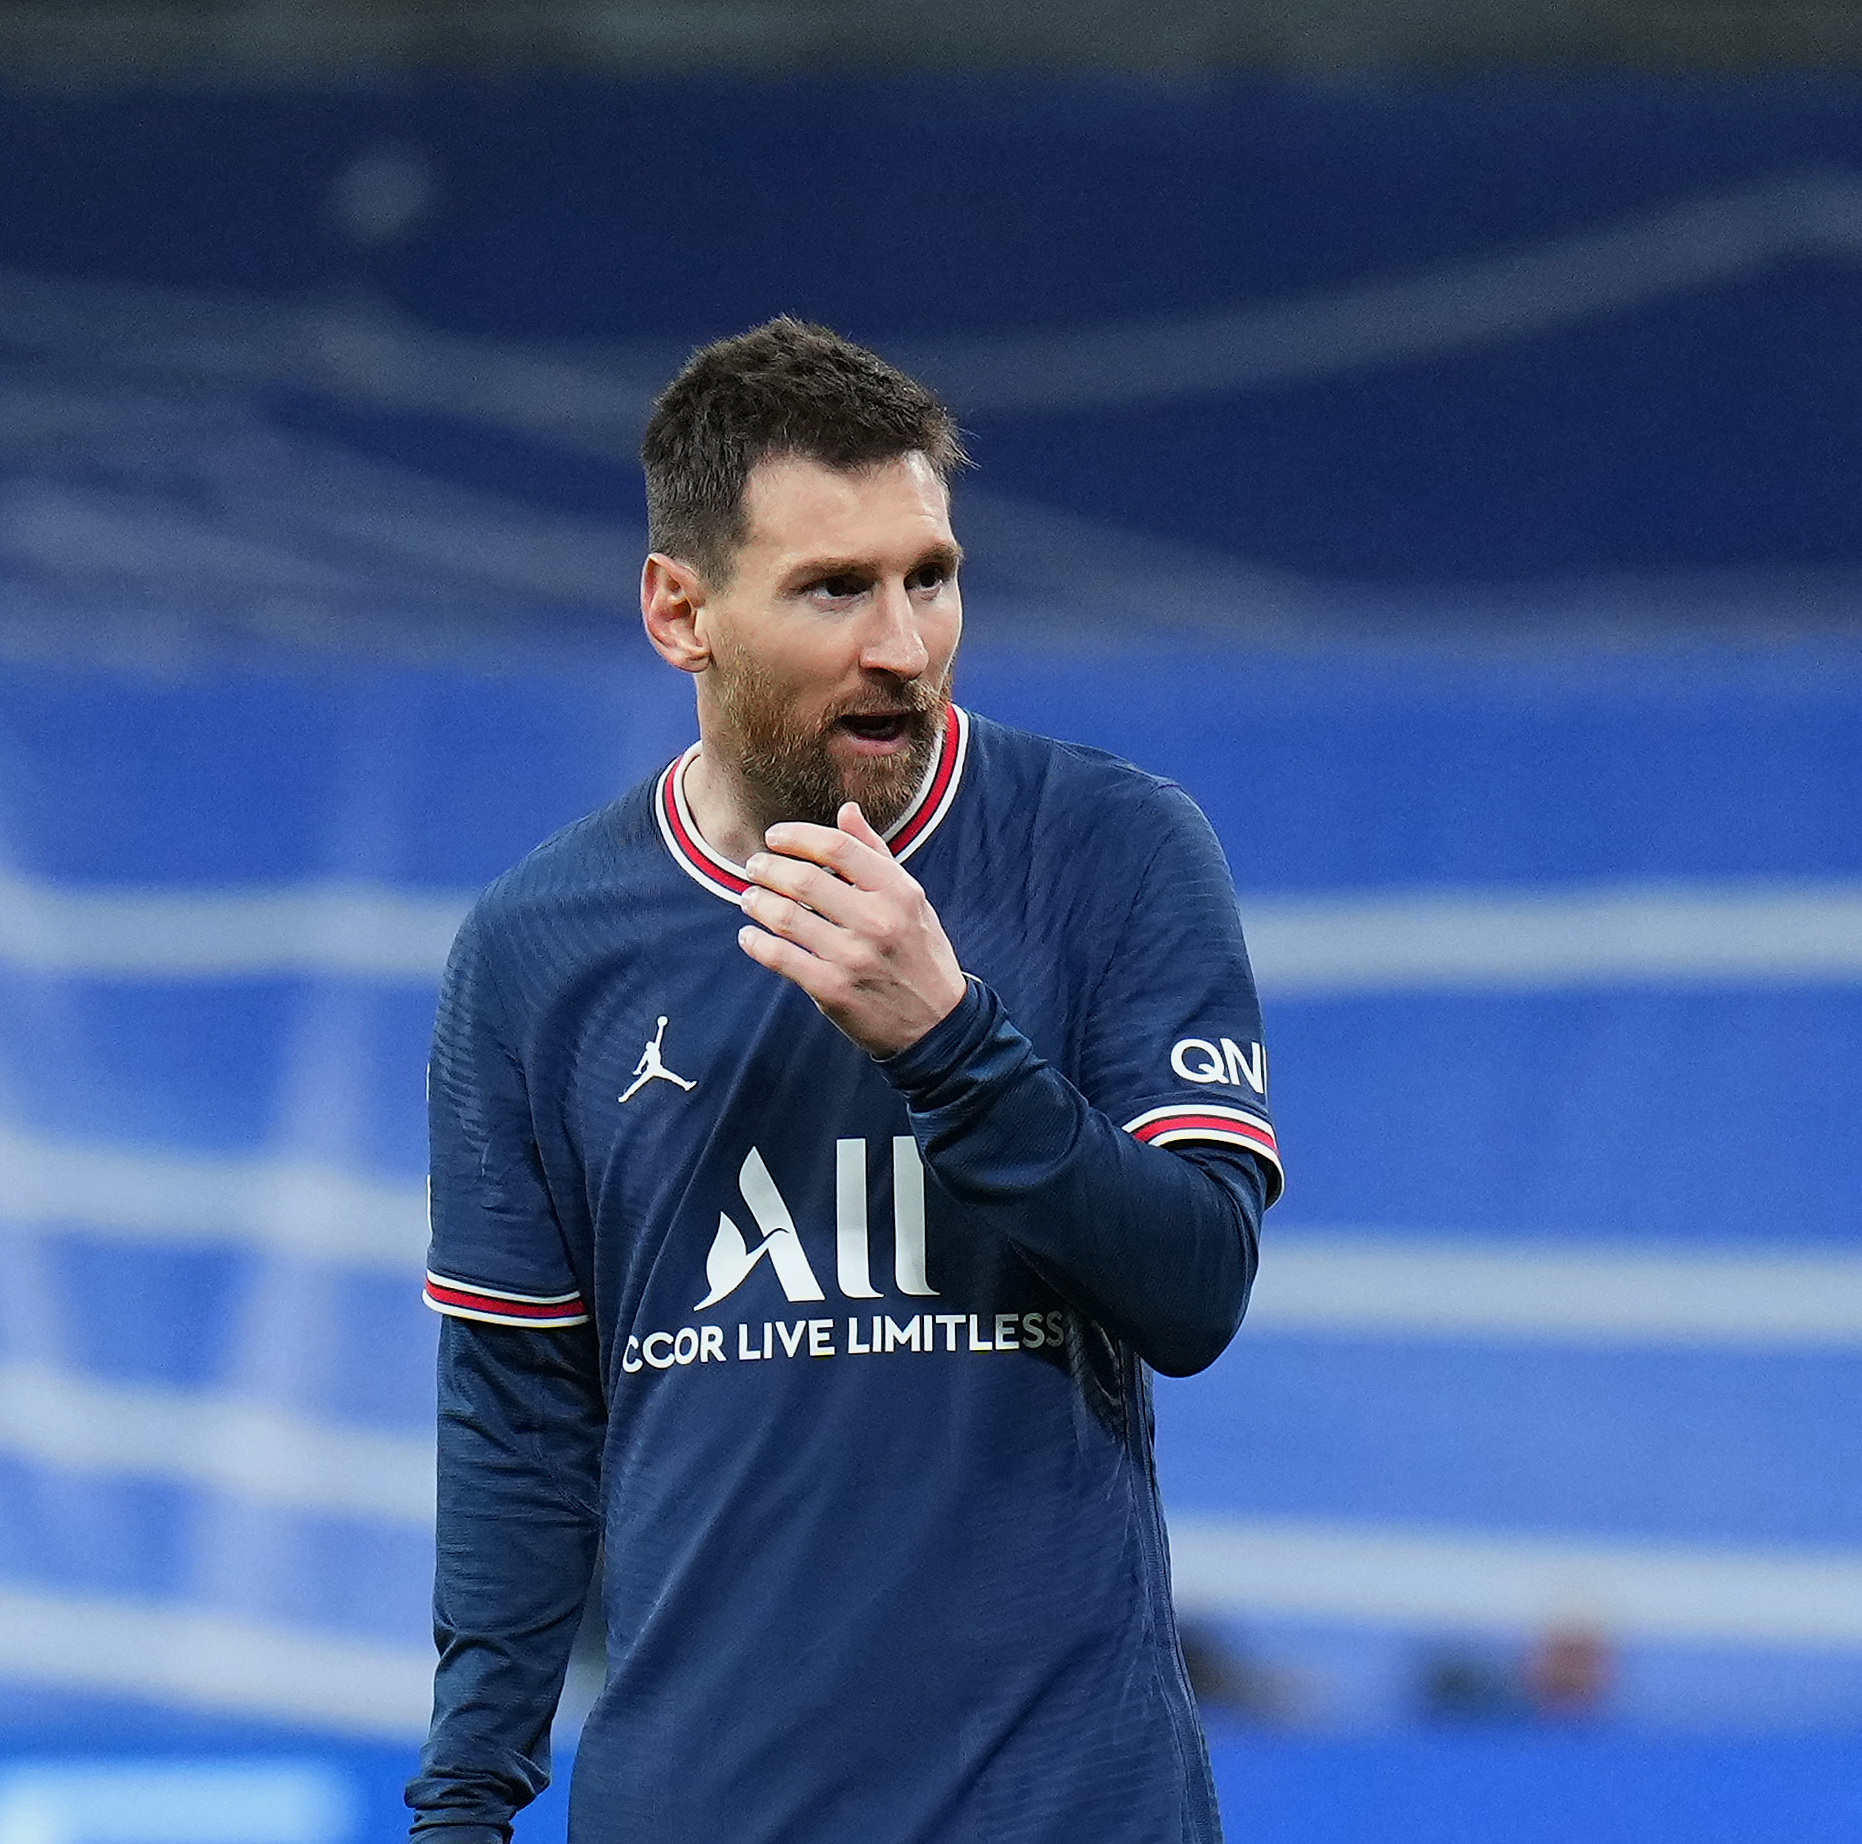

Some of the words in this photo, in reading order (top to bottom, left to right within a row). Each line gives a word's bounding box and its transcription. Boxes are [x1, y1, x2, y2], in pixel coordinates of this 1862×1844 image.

[1170, 1038, 1267, 1094] QN
[621, 1325, 728, 1374] CCOR
[738, 1318, 836, 1361] LIVE
[847, 1310, 1065, 1355] LIMITLESS
